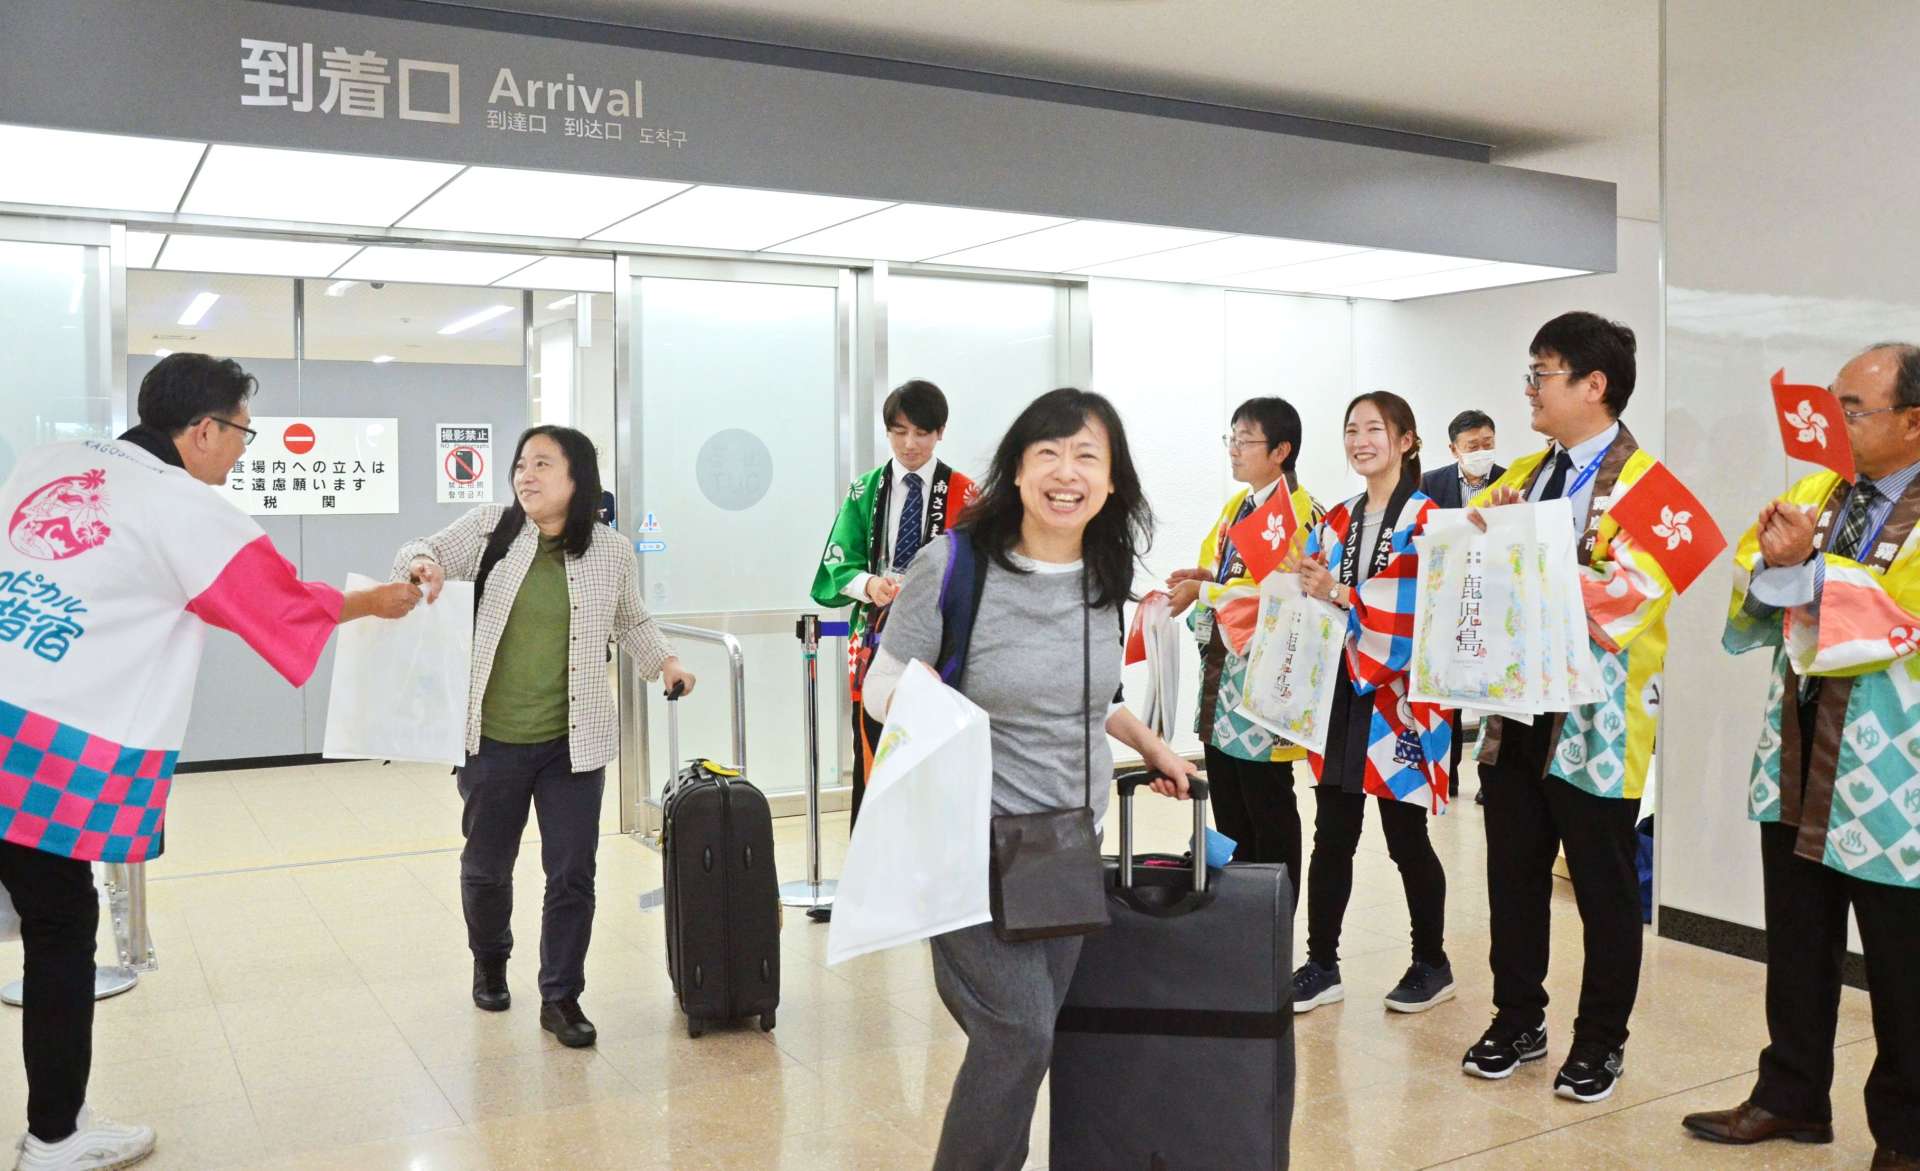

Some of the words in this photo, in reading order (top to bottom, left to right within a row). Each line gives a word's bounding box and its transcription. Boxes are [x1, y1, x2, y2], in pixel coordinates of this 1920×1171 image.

[240, 37, 461, 125] 到着口
[487, 67, 644, 119] Arrival
[486, 109, 548, 134] 到達口
[564, 117, 622, 141] 到达口
[639, 127, 688, 149] 도착구
[441, 429, 489, 441] 撮影禁止
[231, 477, 366, 492] ご遠慮願います
[263, 495, 336, 509] 税関
[1374, 527, 1393, 577] あなた
